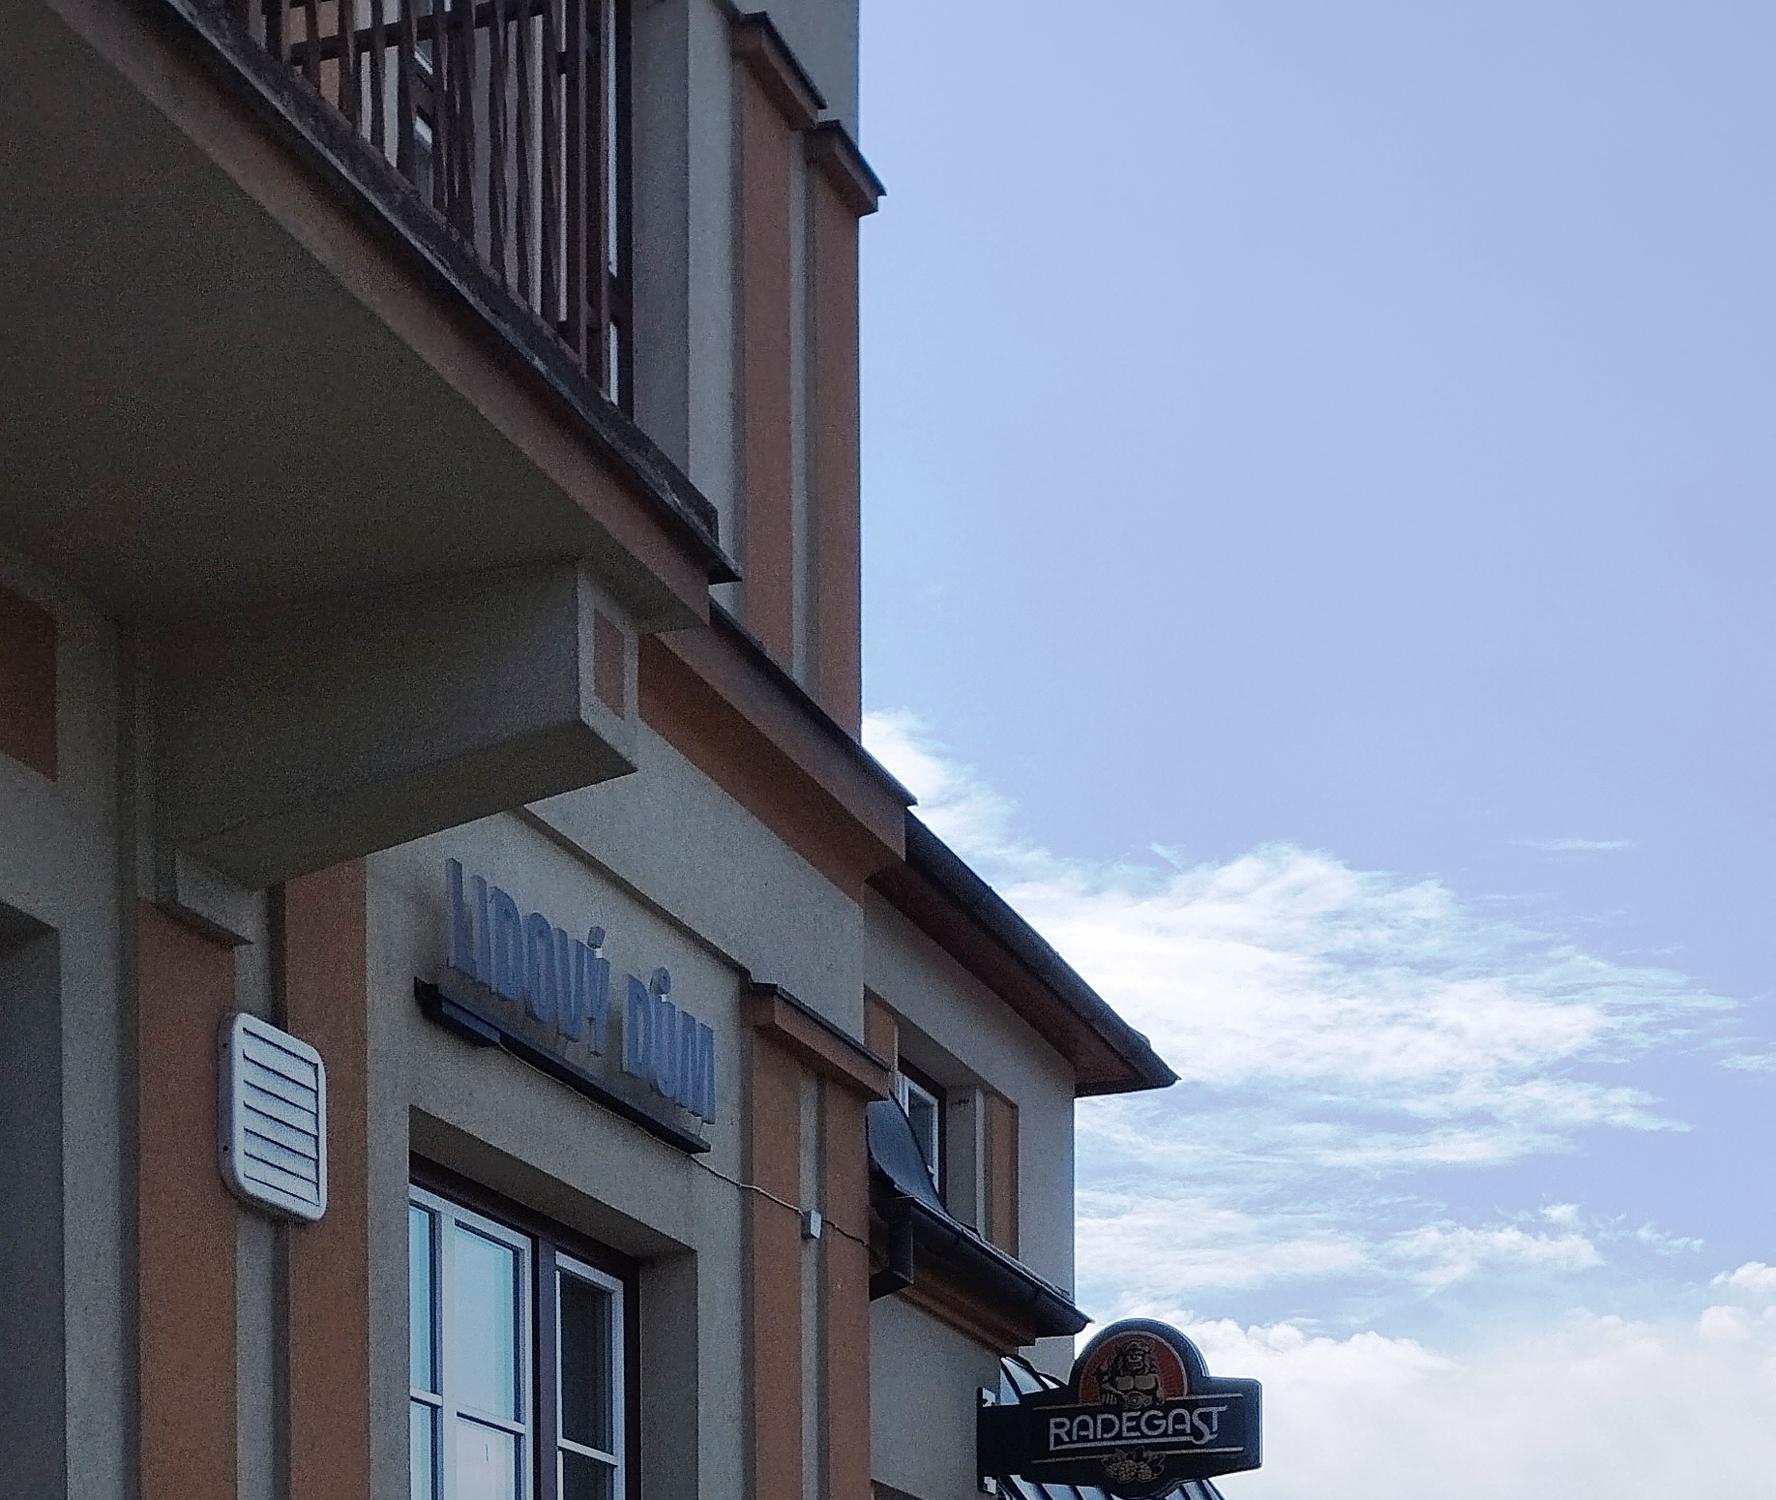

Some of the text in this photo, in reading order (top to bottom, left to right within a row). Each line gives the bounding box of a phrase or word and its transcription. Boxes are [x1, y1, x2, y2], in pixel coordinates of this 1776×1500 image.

[445, 857, 716, 1125] LIDOVÝ DŮM
[1049, 1404, 1229, 1450] RADEGAST
